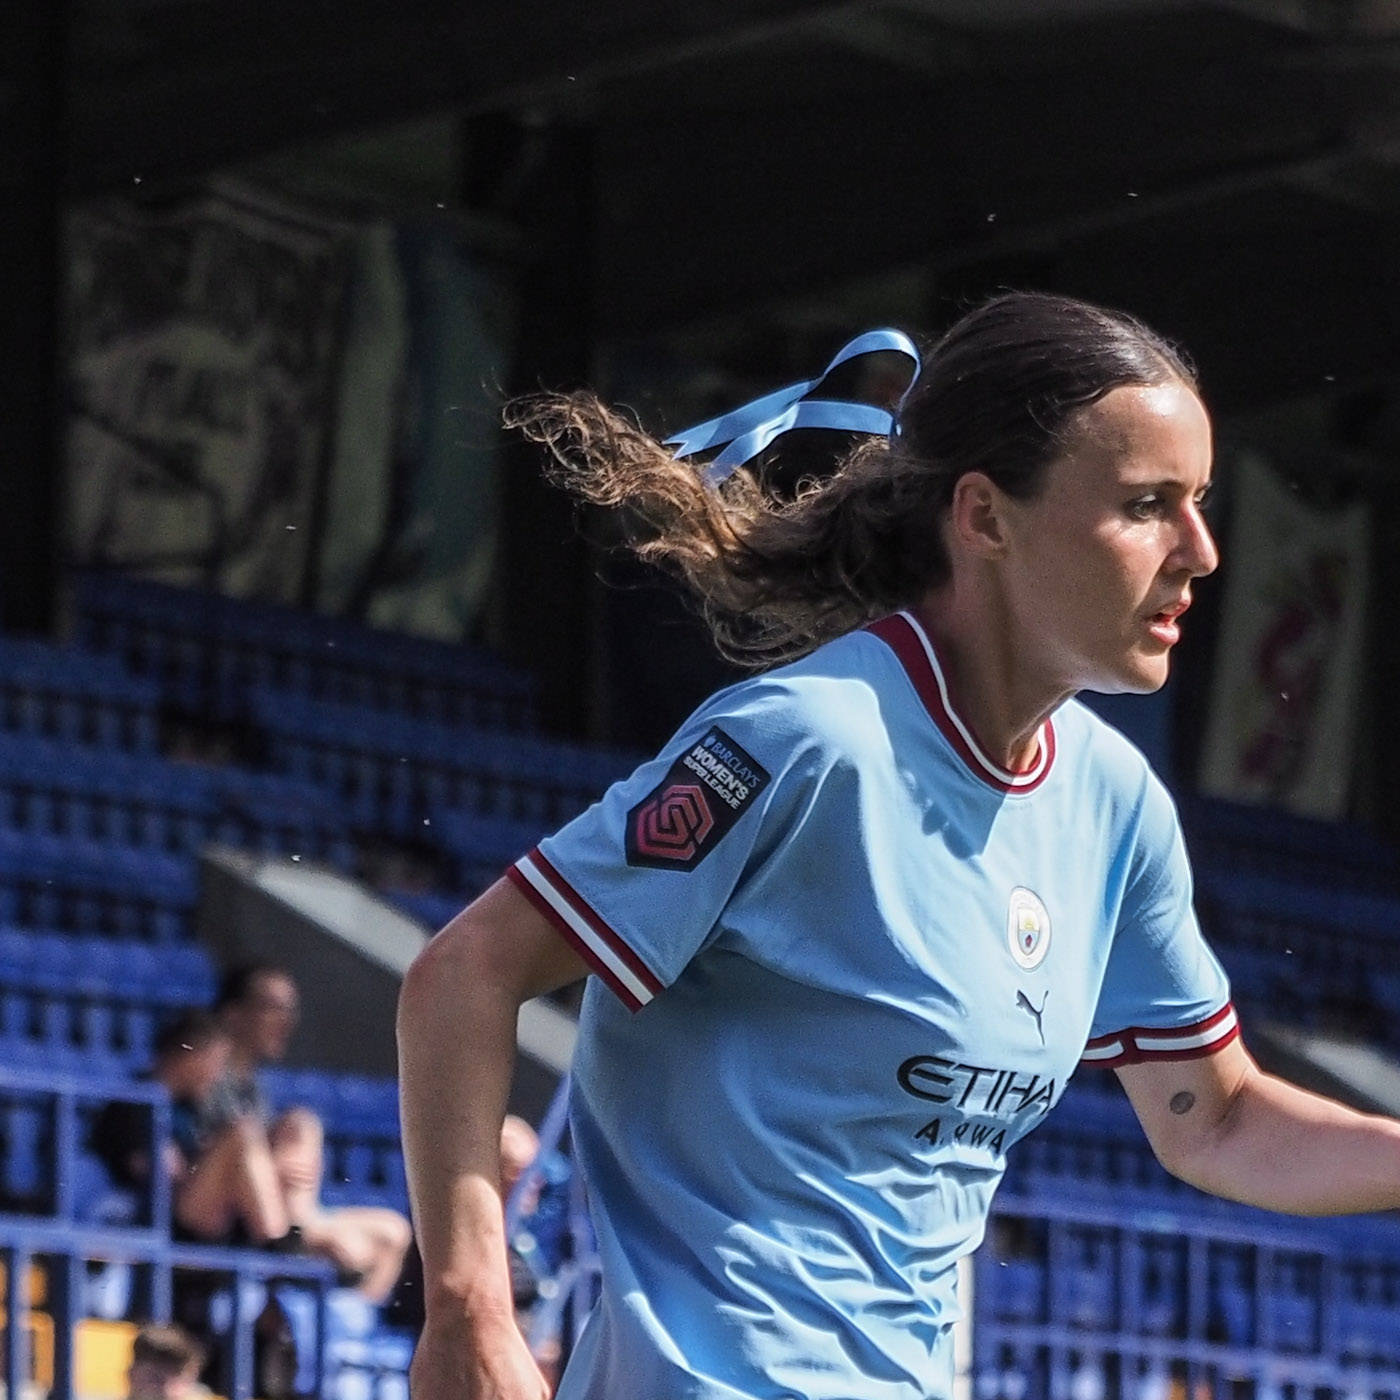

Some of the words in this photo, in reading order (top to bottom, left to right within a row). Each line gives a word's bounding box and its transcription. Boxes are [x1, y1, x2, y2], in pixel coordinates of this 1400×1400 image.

[691, 745, 749, 800] WOMEN'S
[711, 742, 760, 788] BARCLAYS
[704, 774, 741, 810] LEAGUE
